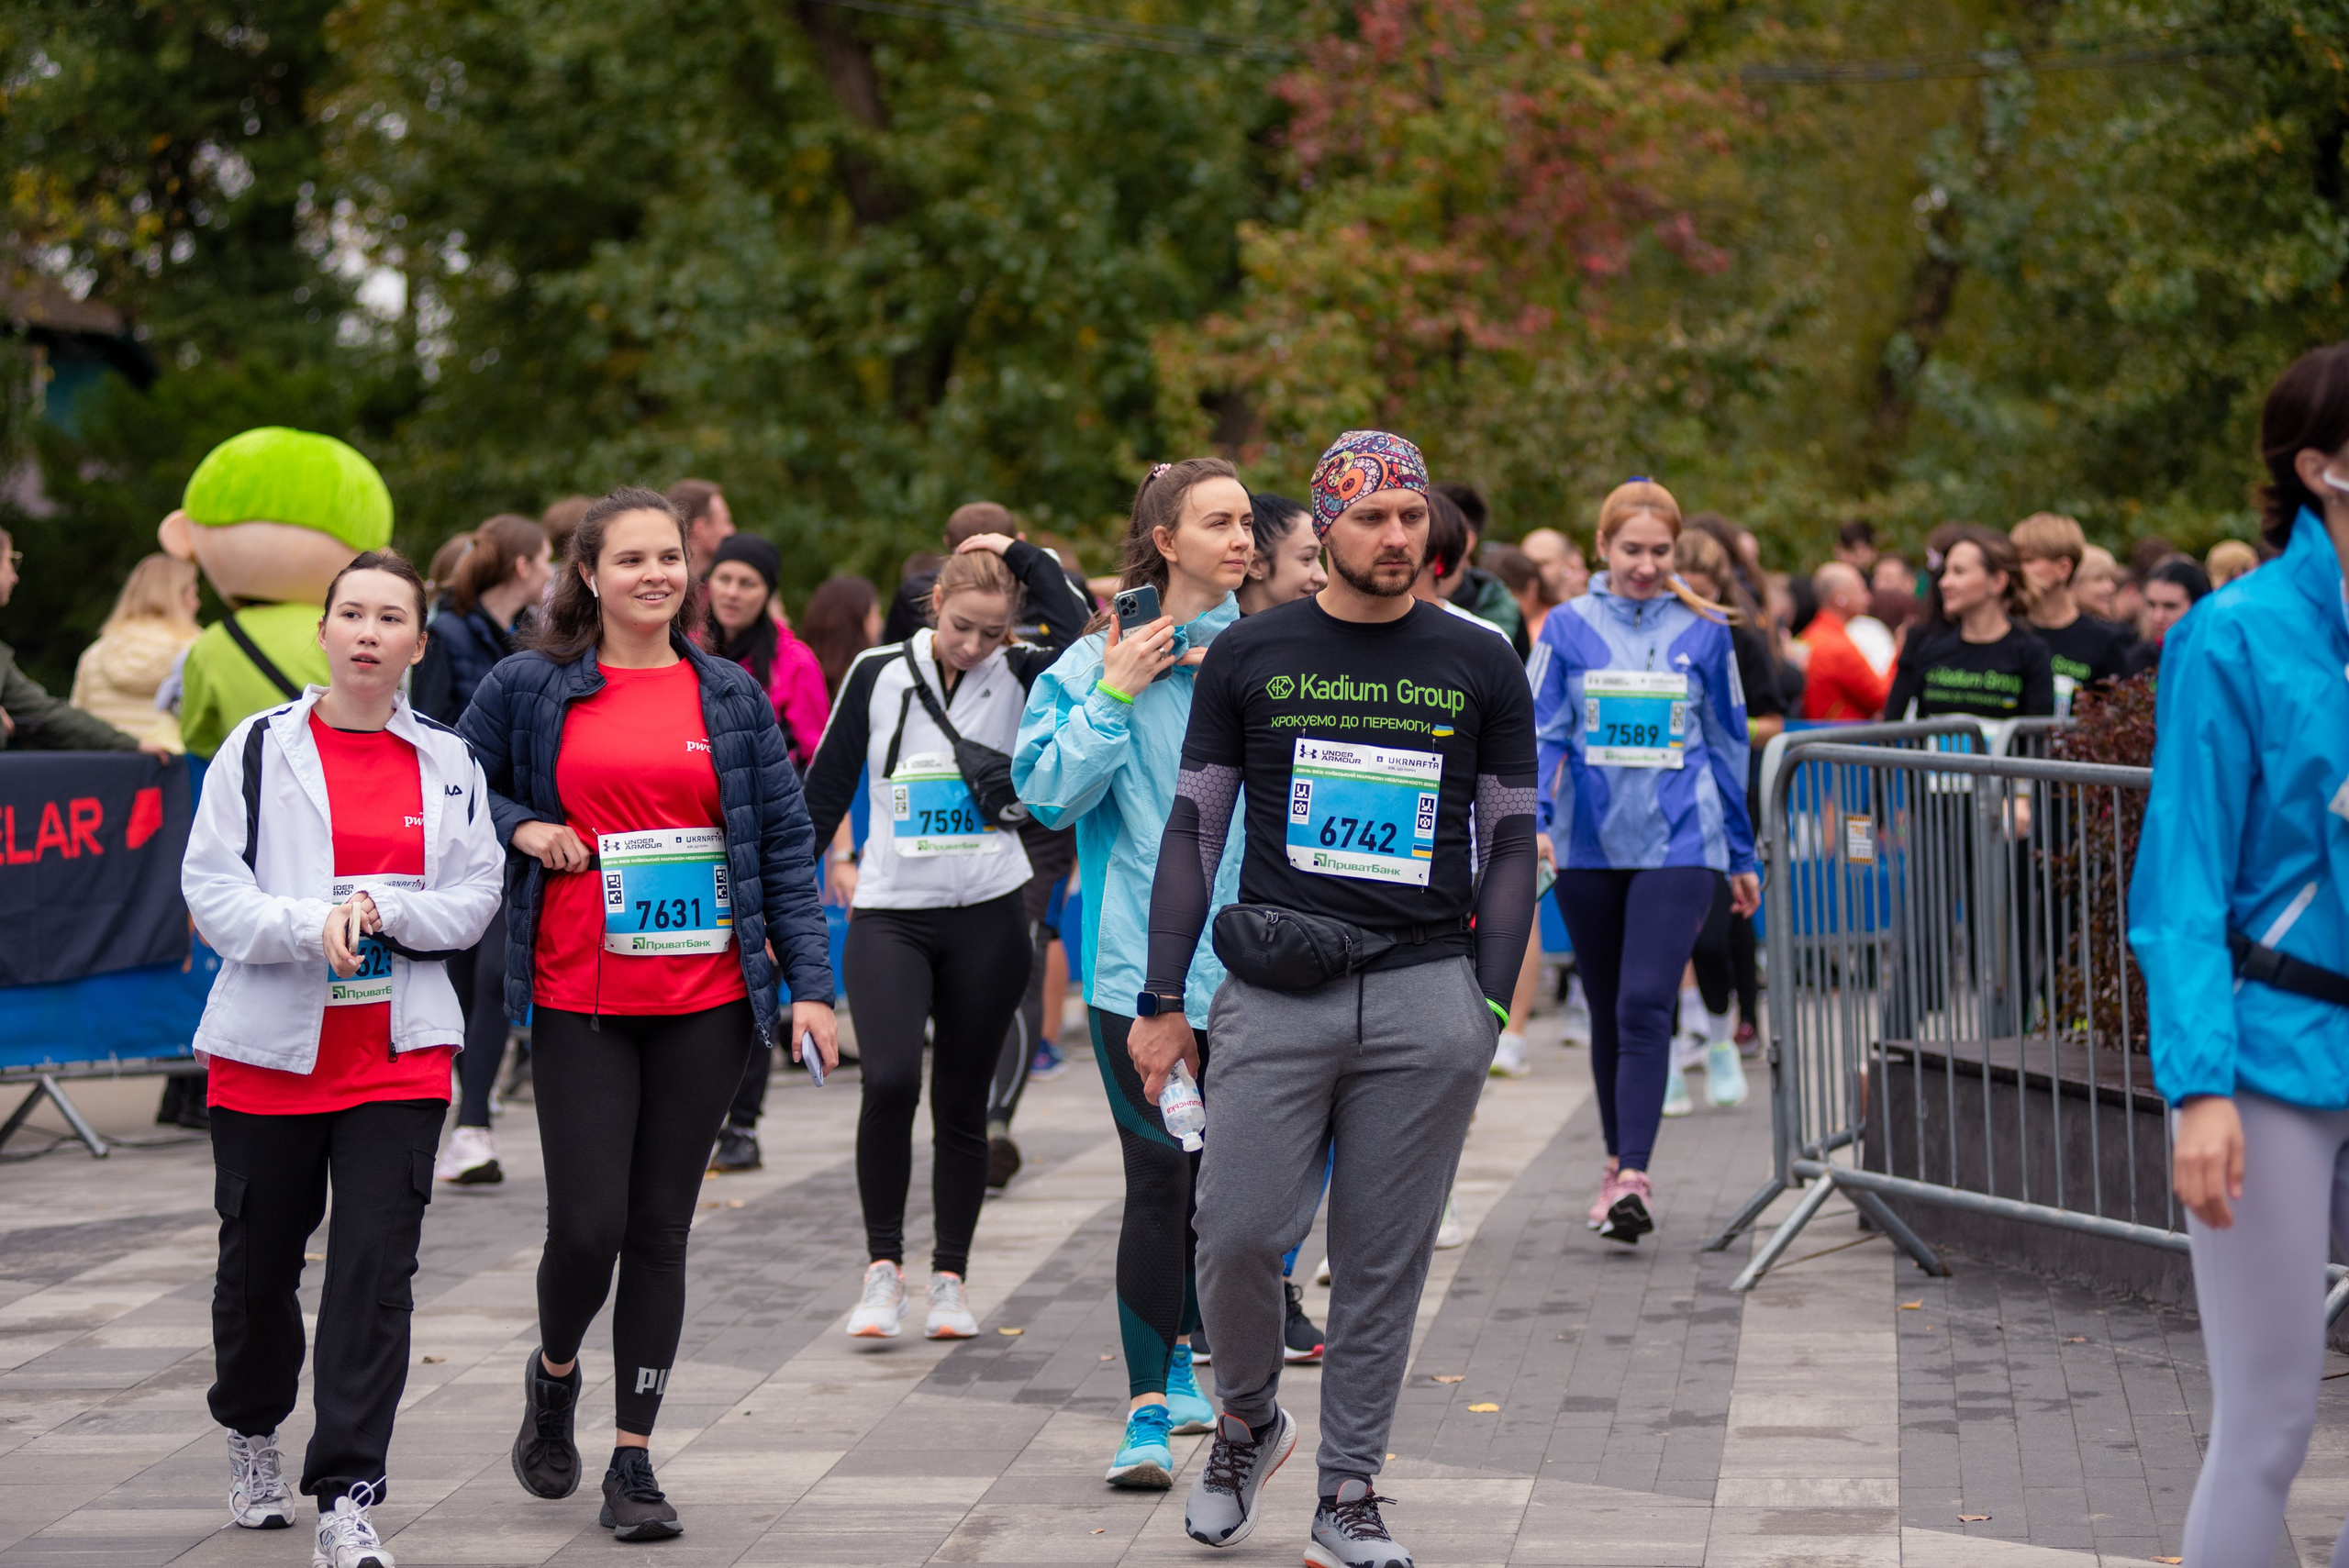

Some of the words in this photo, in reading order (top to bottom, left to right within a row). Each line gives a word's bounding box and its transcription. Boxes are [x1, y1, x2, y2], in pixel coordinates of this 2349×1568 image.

[1299, 673, 1388, 703] Kadium
[1397, 679, 1464, 717] Group
[1340, 715, 1359, 729] ДО
[1363, 717, 1431, 734] ПЕРЕМОГИ
[1606, 723, 1660, 747] 7589
[1321, 755, 1362, 764] ARMOUR
[1322, 750, 1353, 758] UNDER
[1388, 757, 1440, 770] UKRNAFTA
[0, 796, 105, 866] LAR
[918, 809, 974, 834] 7596
[686, 835, 723, 843] UKRNAFTA
[1319, 817, 1397, 854] 6742
[1327, 859, 1401, 876] ПриватБанк
[636, 898, 701, 930] 7631
[646, 940, 711, 951] ПриватБанк
